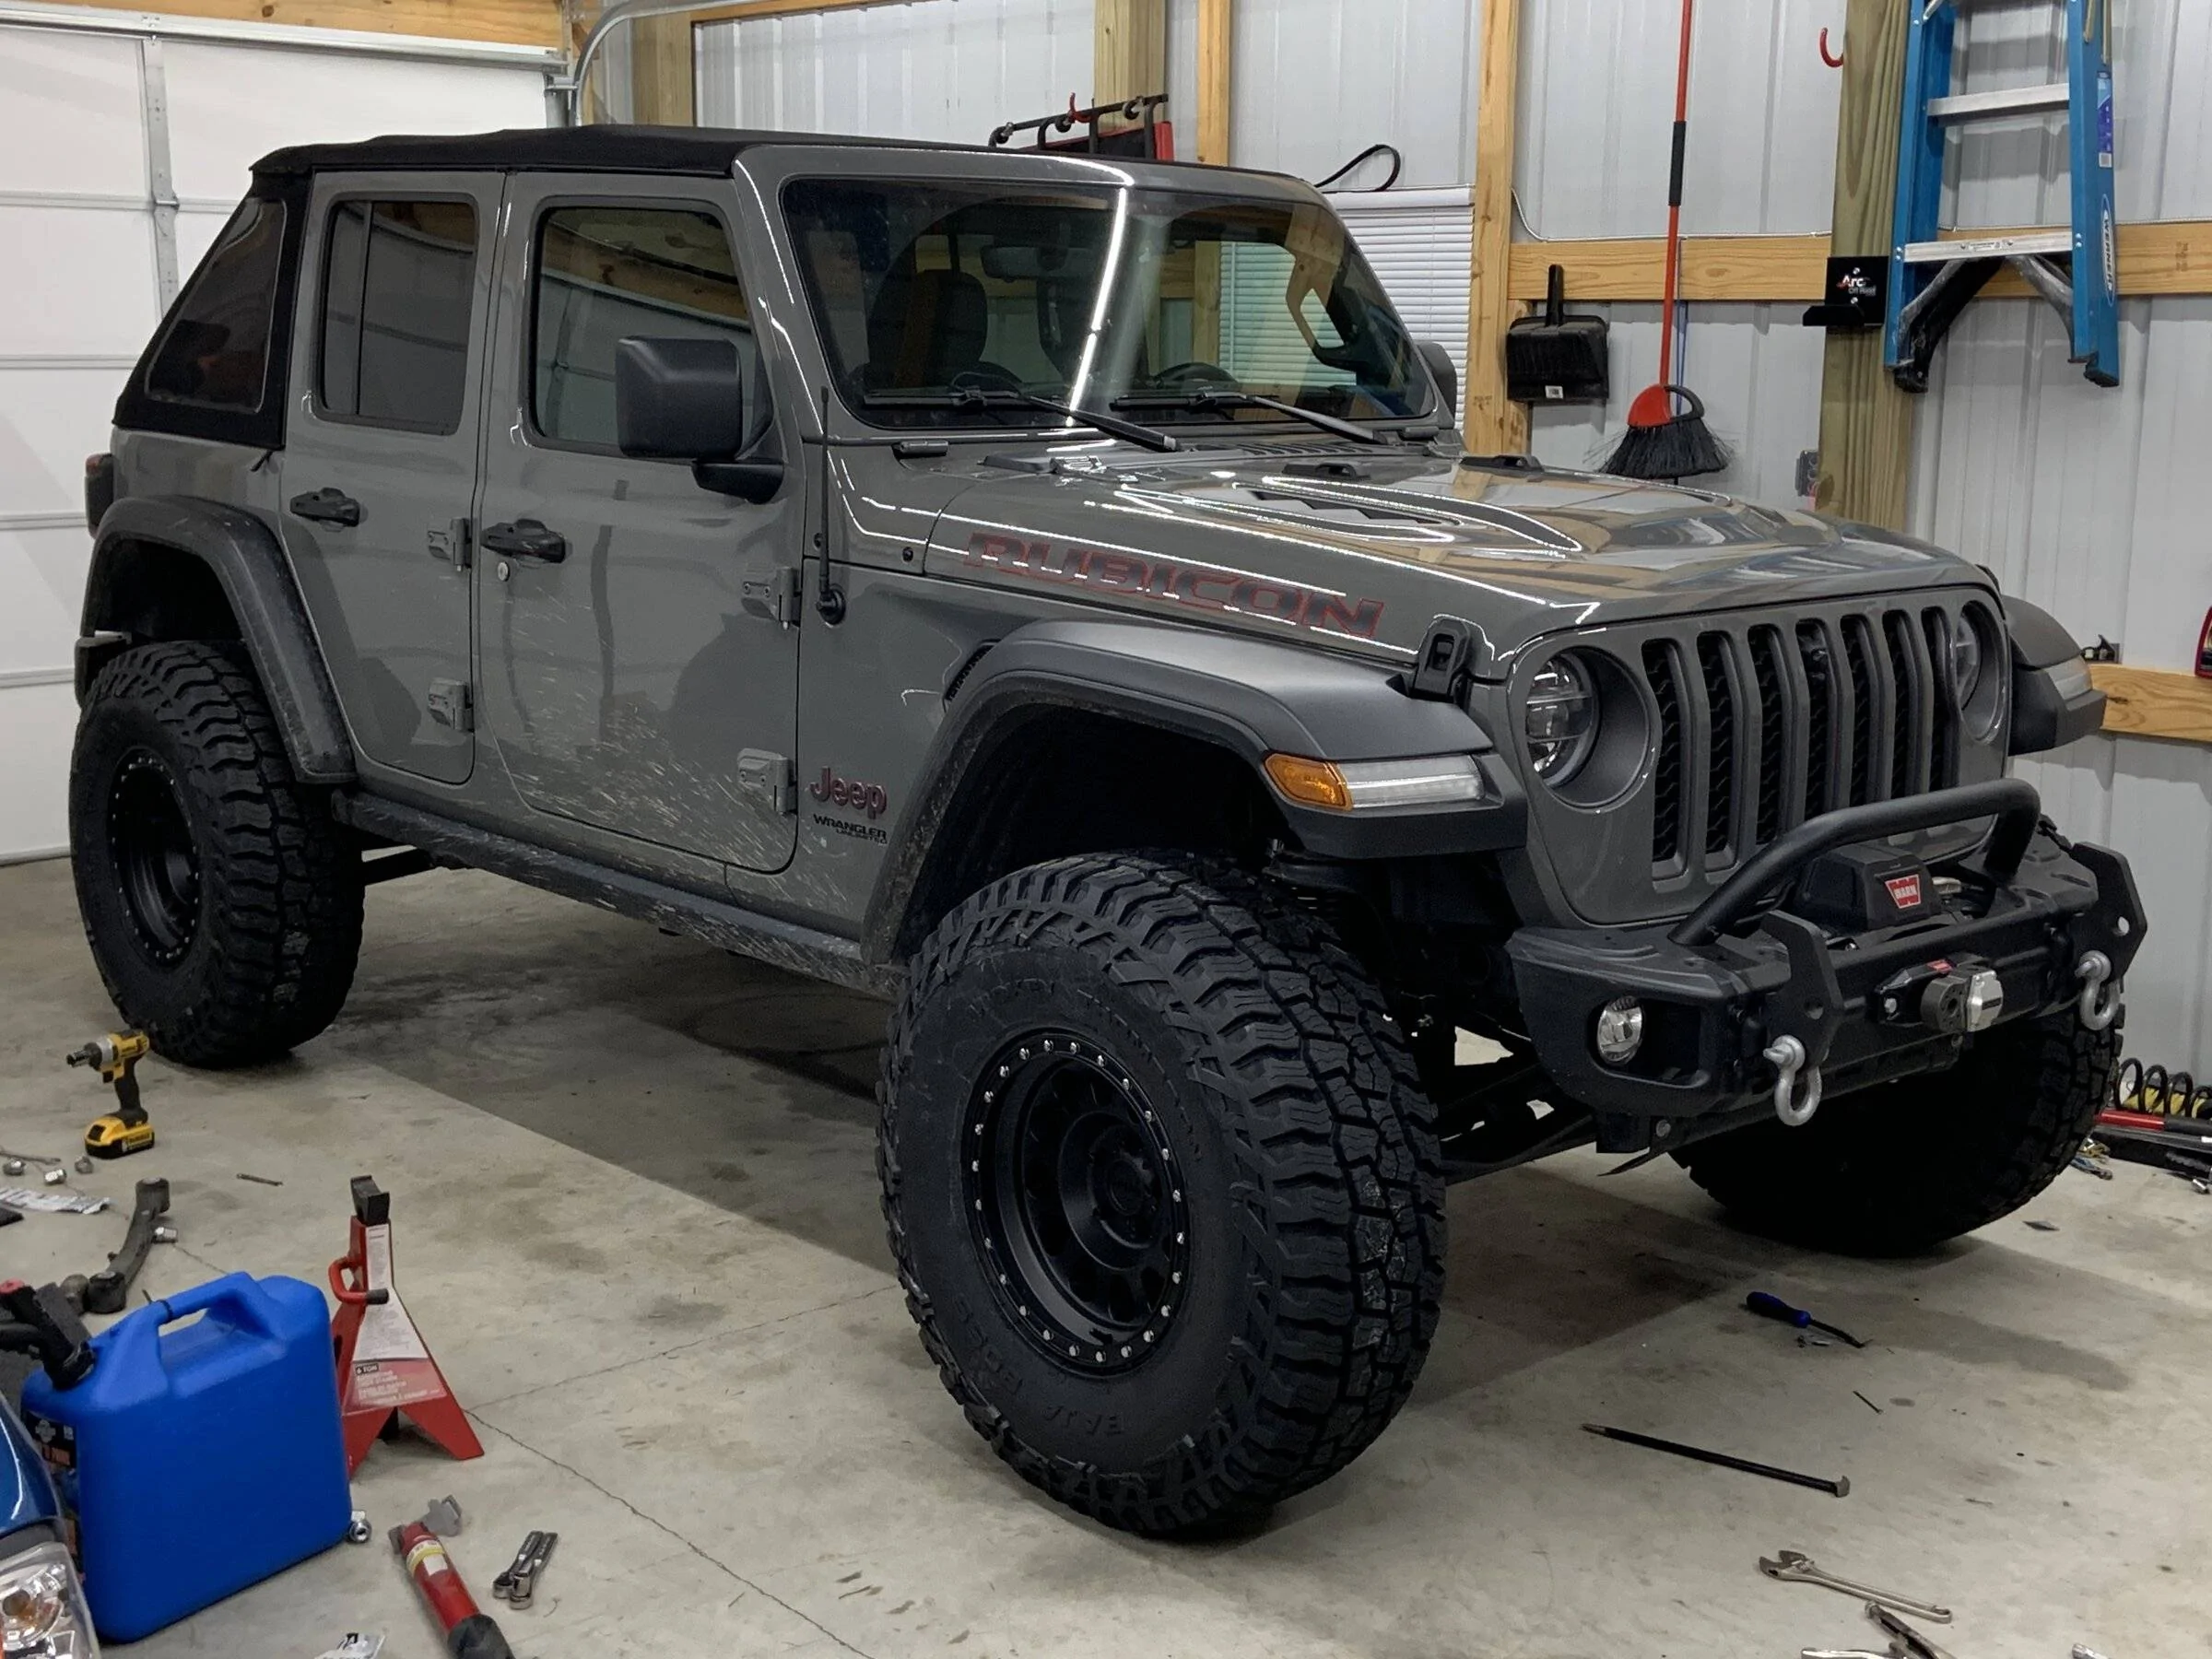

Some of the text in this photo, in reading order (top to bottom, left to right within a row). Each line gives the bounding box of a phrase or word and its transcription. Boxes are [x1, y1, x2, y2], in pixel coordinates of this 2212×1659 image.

[2103, 218, 2113, 284] WERNER
[1842, 275, 1865, 288] Arc
[964, 532, 1384, 639] RUBICON
[810, 765, 887, 819] Jeep
[813, 814, 888, 841] WRANGLER
